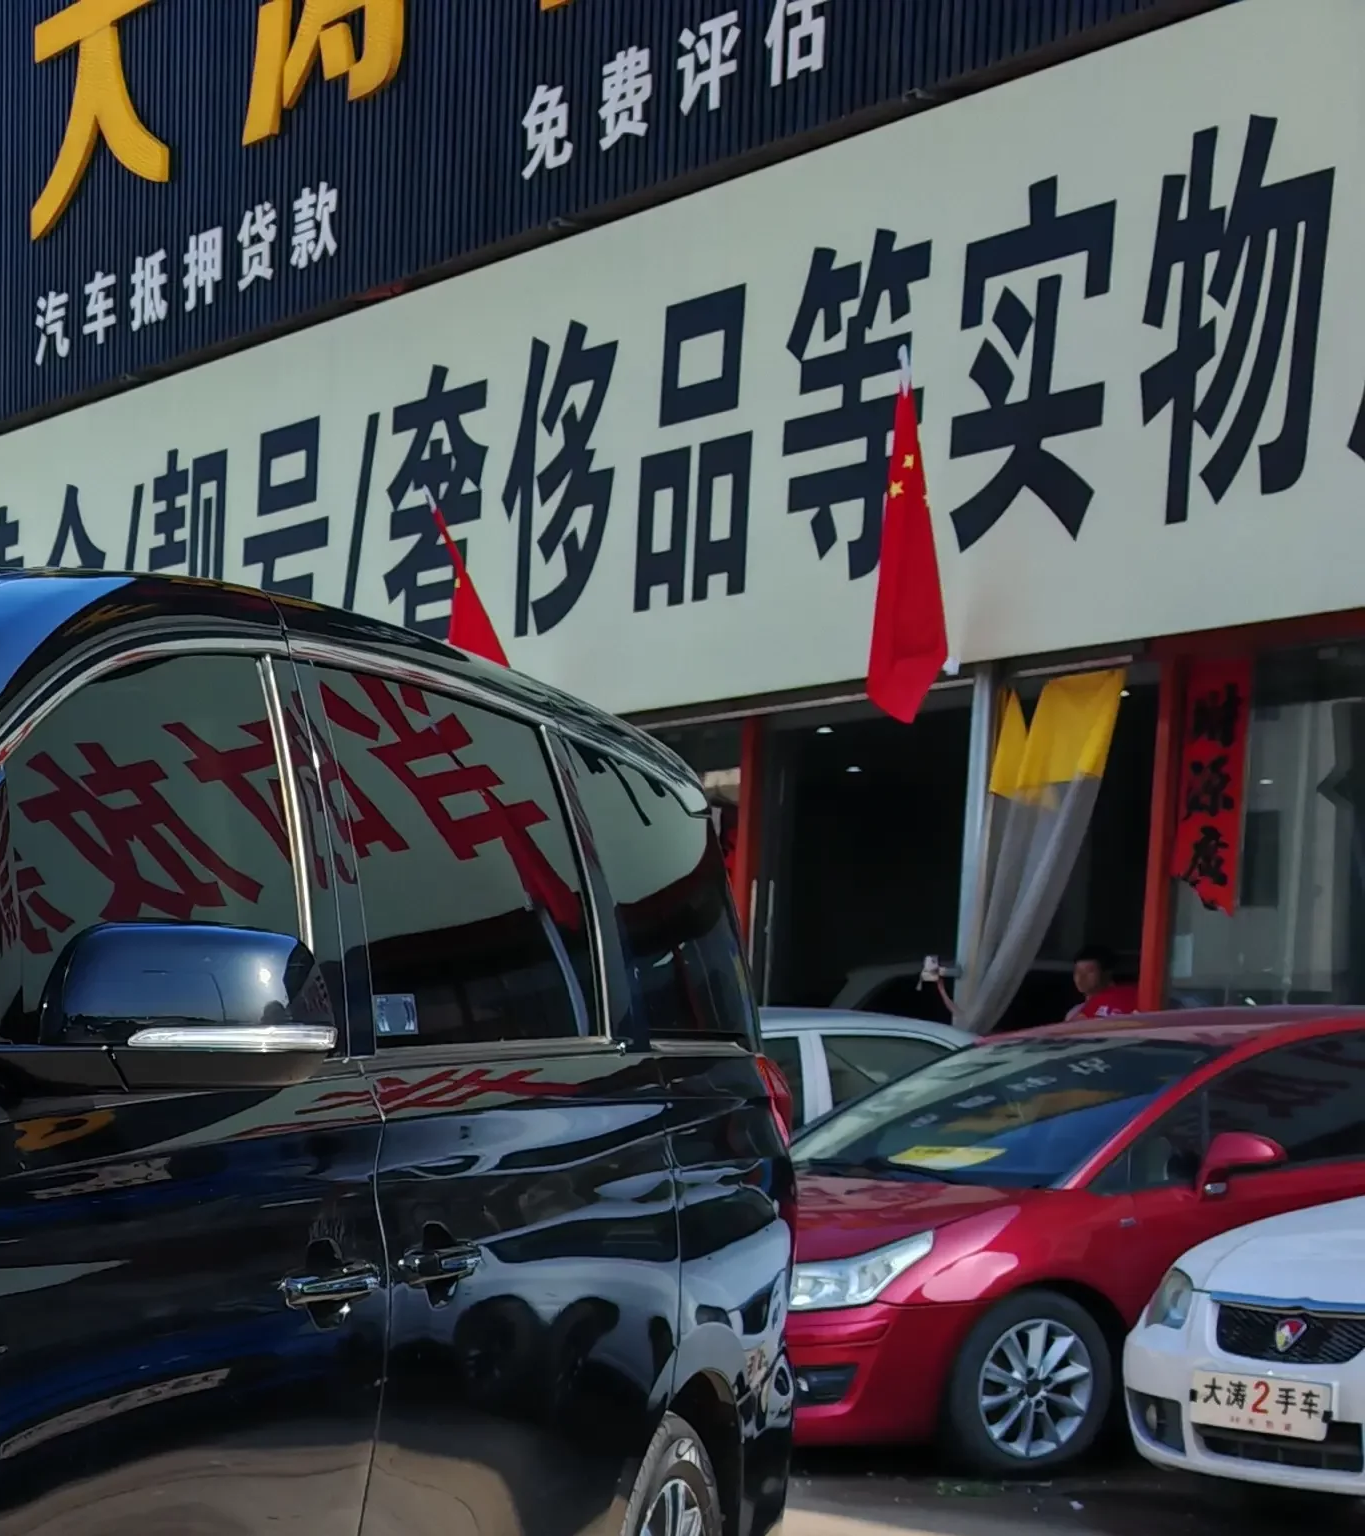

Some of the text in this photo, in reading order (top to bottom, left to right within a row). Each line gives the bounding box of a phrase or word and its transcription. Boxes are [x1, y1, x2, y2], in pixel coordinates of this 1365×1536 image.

[521, 0, 831, 181] 免费评估
[35, 181, 340, 368] 汽车抵押贷款
[1203, 1377, 1320, 1419] 大涛2手车
